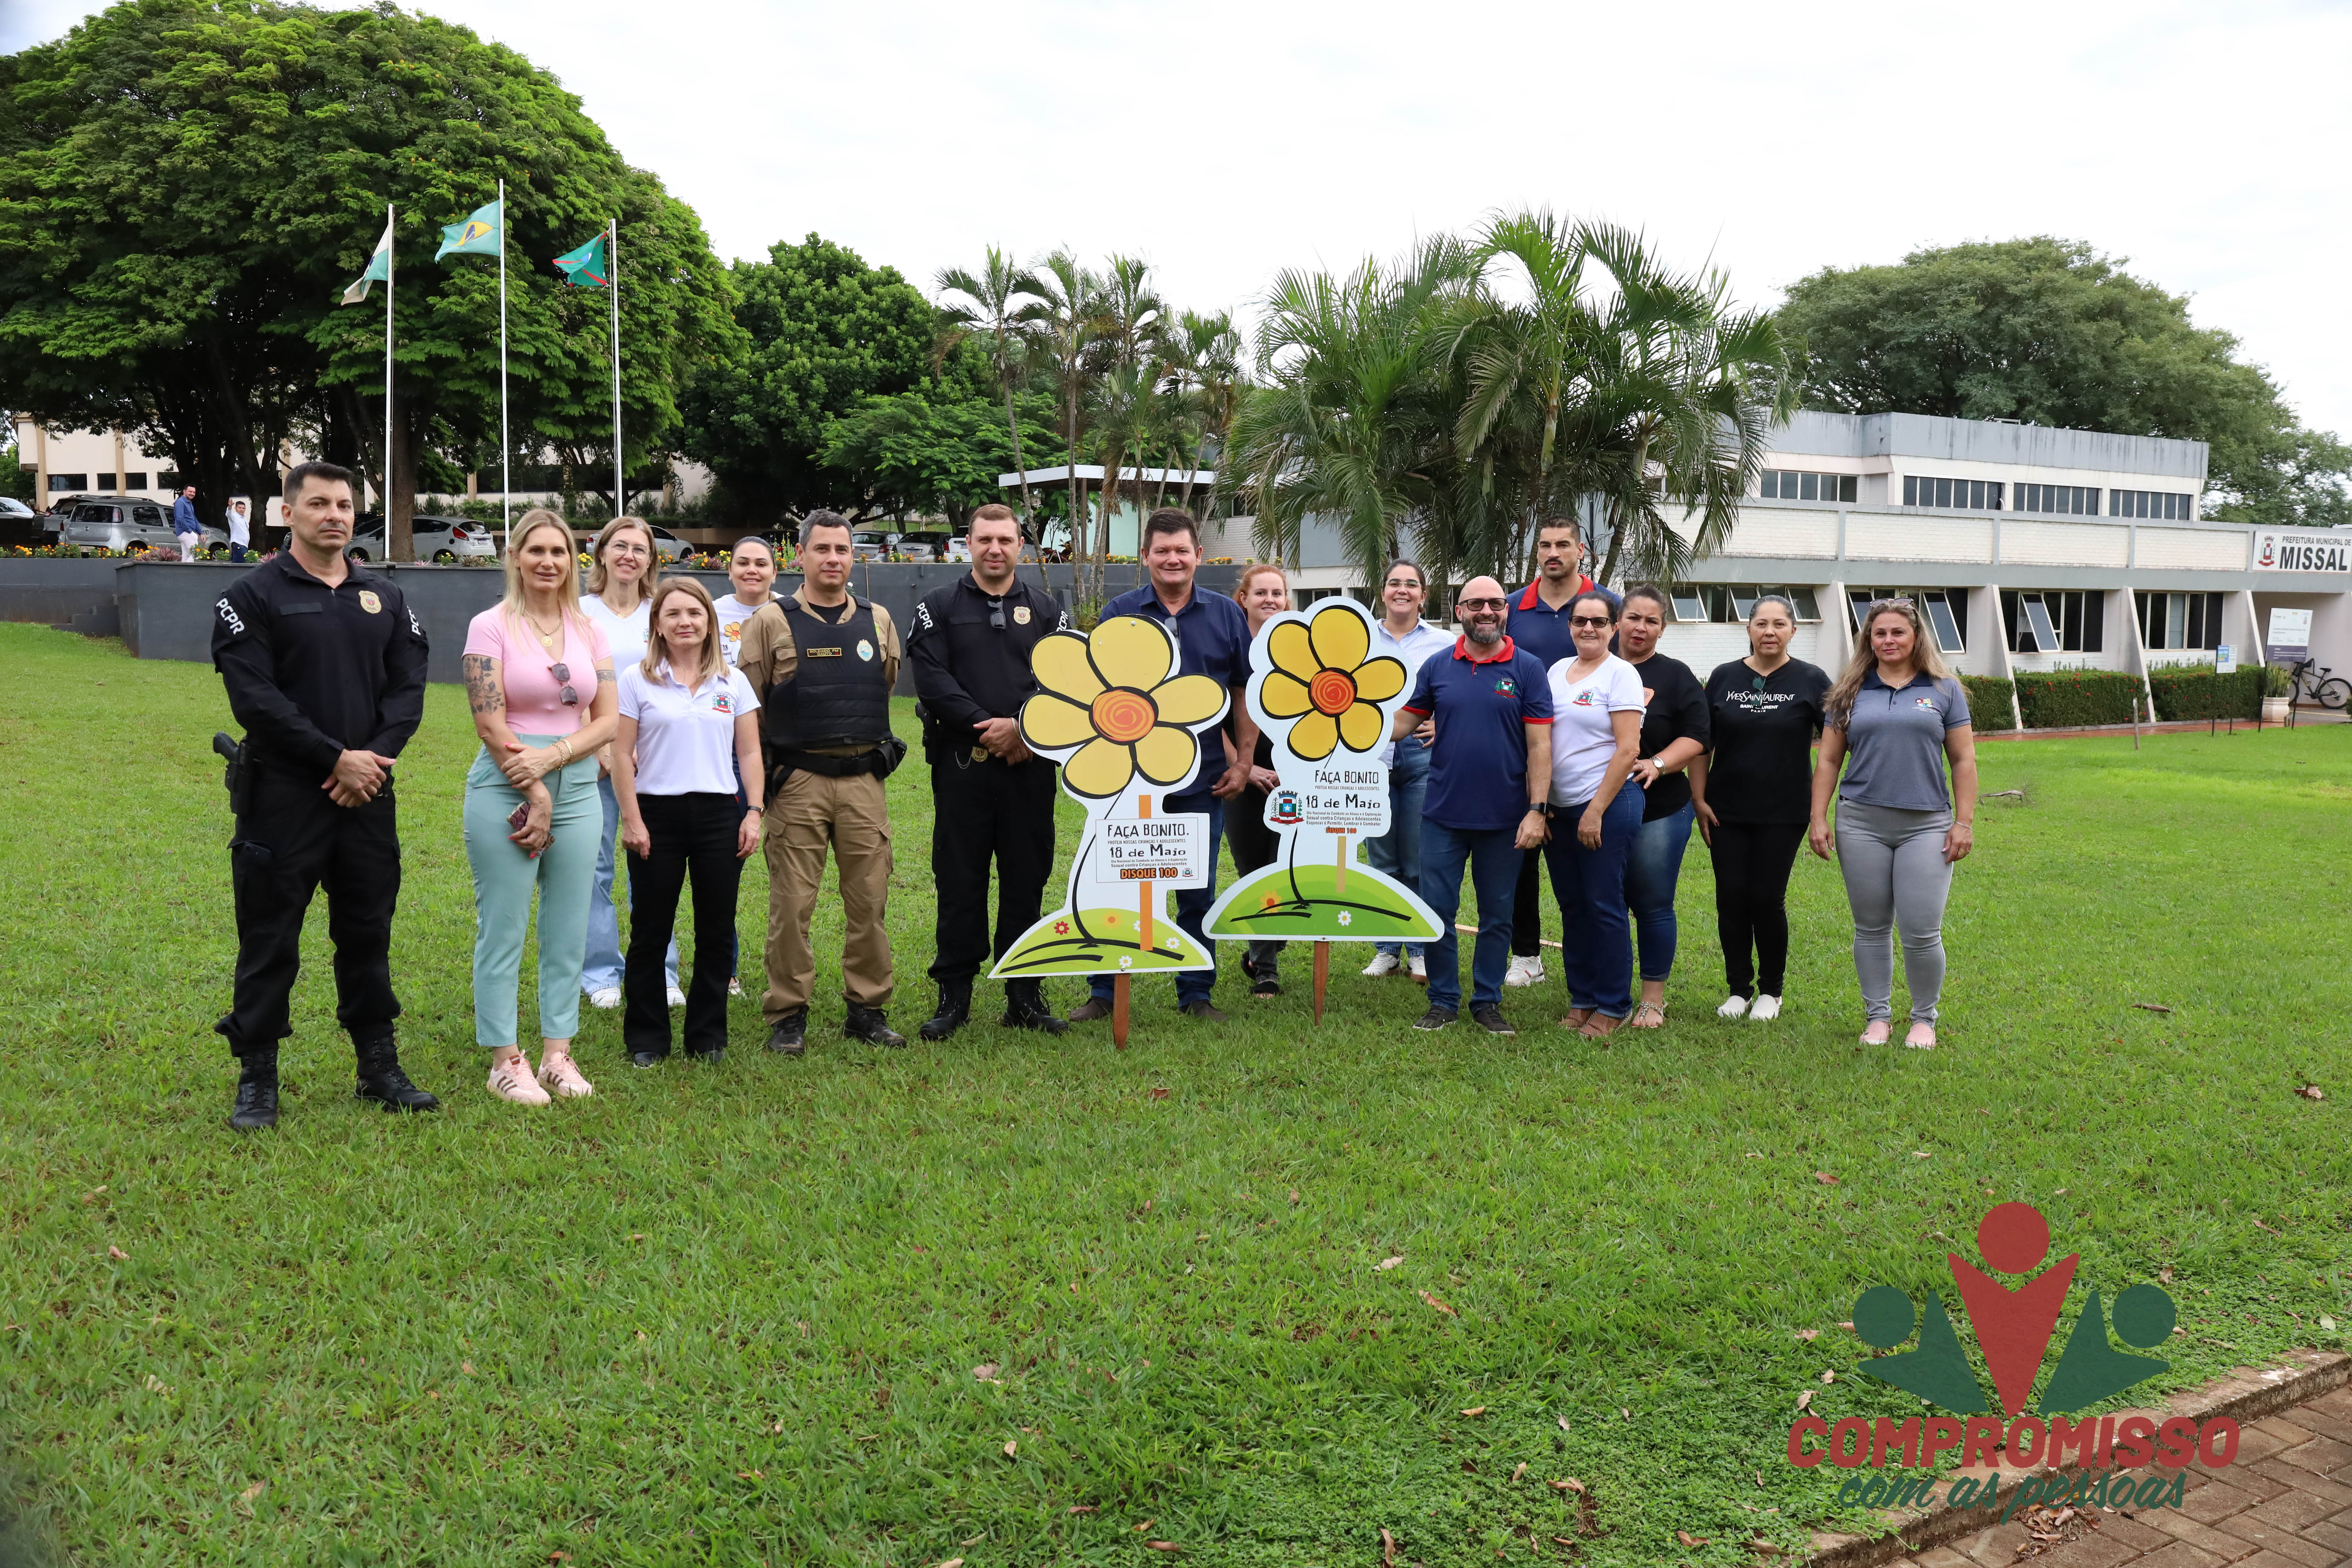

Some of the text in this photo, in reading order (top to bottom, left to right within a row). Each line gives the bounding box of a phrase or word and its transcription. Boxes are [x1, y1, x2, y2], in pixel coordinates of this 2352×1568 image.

[2279, 546, 2347, 571] MISSAL
[216, 598, 245, 635] PCPR
[916, 602, 933, 630] PCPR
[1315, 770, 1379, 784] FAÇA BONITO
[1306, 793, 1381, 809] 18 de Maio
[1107, 824, 1190, 839] FAÇA BONITO.
[1110, 844, 1186, 858] 18 de Maio
[1120, 867, 1178, 879] DISQUE 100
